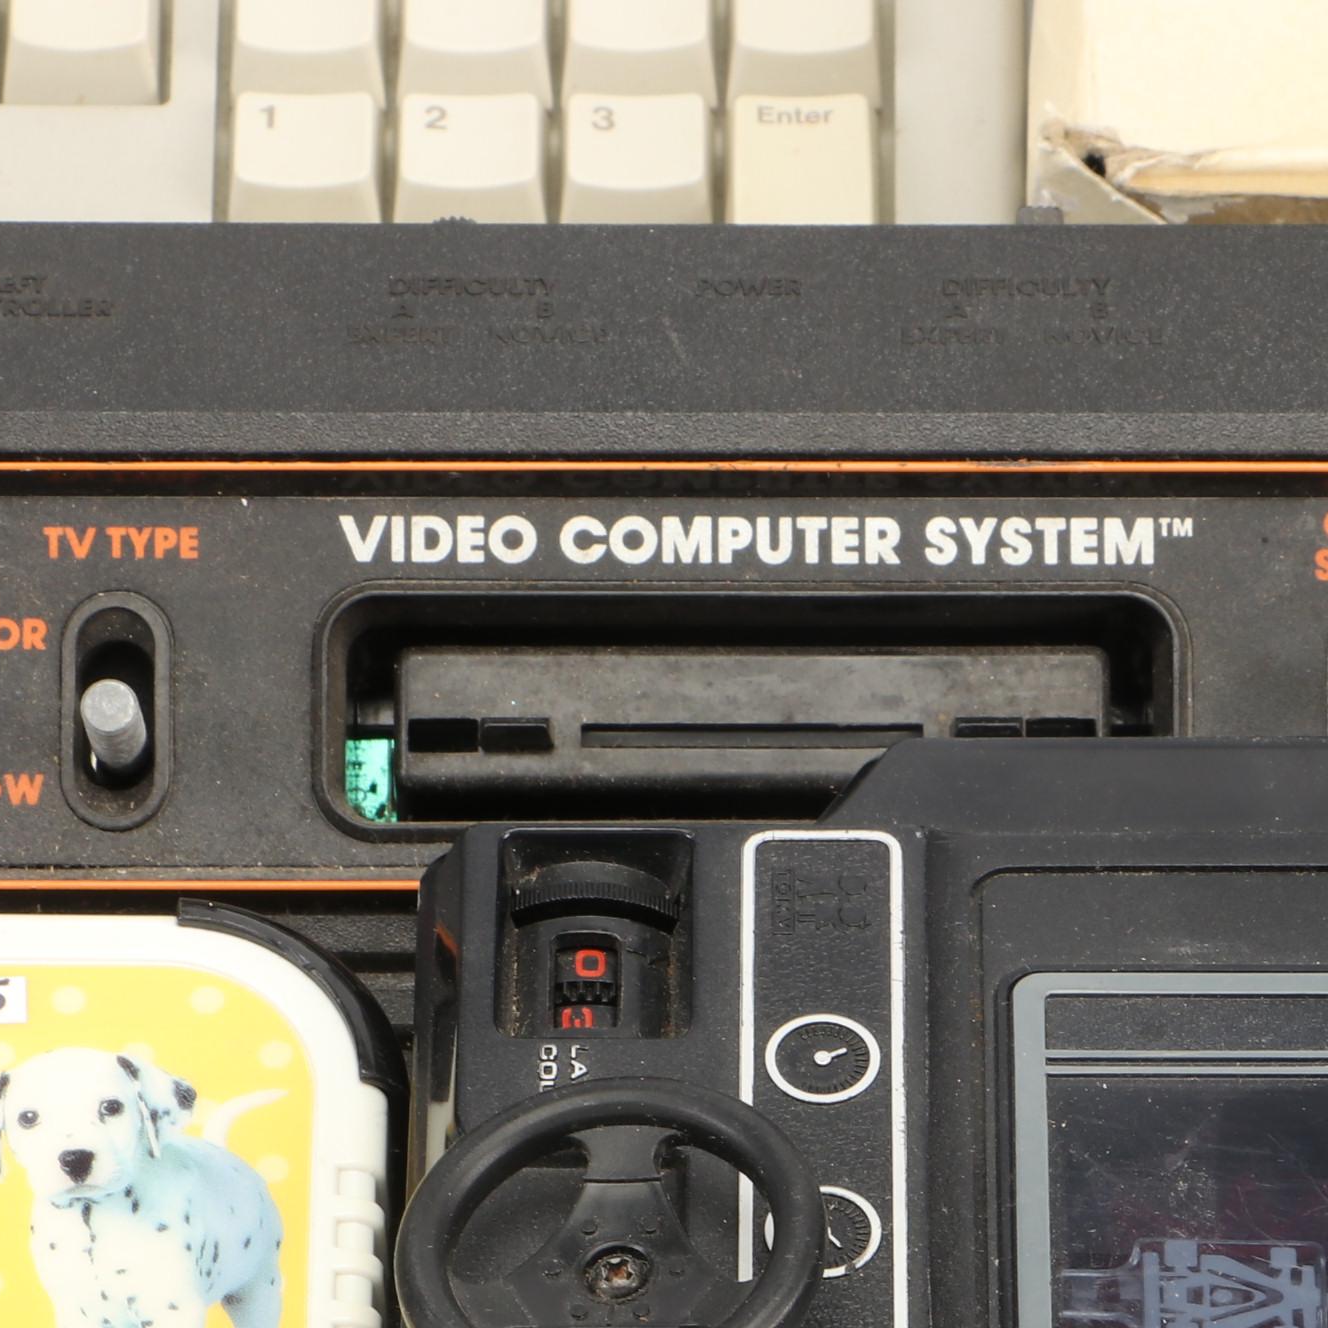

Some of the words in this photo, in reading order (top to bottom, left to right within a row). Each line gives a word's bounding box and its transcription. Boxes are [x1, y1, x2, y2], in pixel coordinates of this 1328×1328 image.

[257, 105, 278, 131] 1
[422, 105, 449, 132] 2
[590, 105, 616, 132] 3
[756, 104, 834, 128] Enter
[387, 277, 556, 297] DIFFICULTY
[695, 277, 804, 298] POWER
[941, 277, 1113, 298] DIFFICULTY
[41, 525, 99, 560] TV
[105, 525, 200, 560] TYPE
[337, 514, 539, 565] VIDEO
[558, 514, 902, 567] COMPUTER
